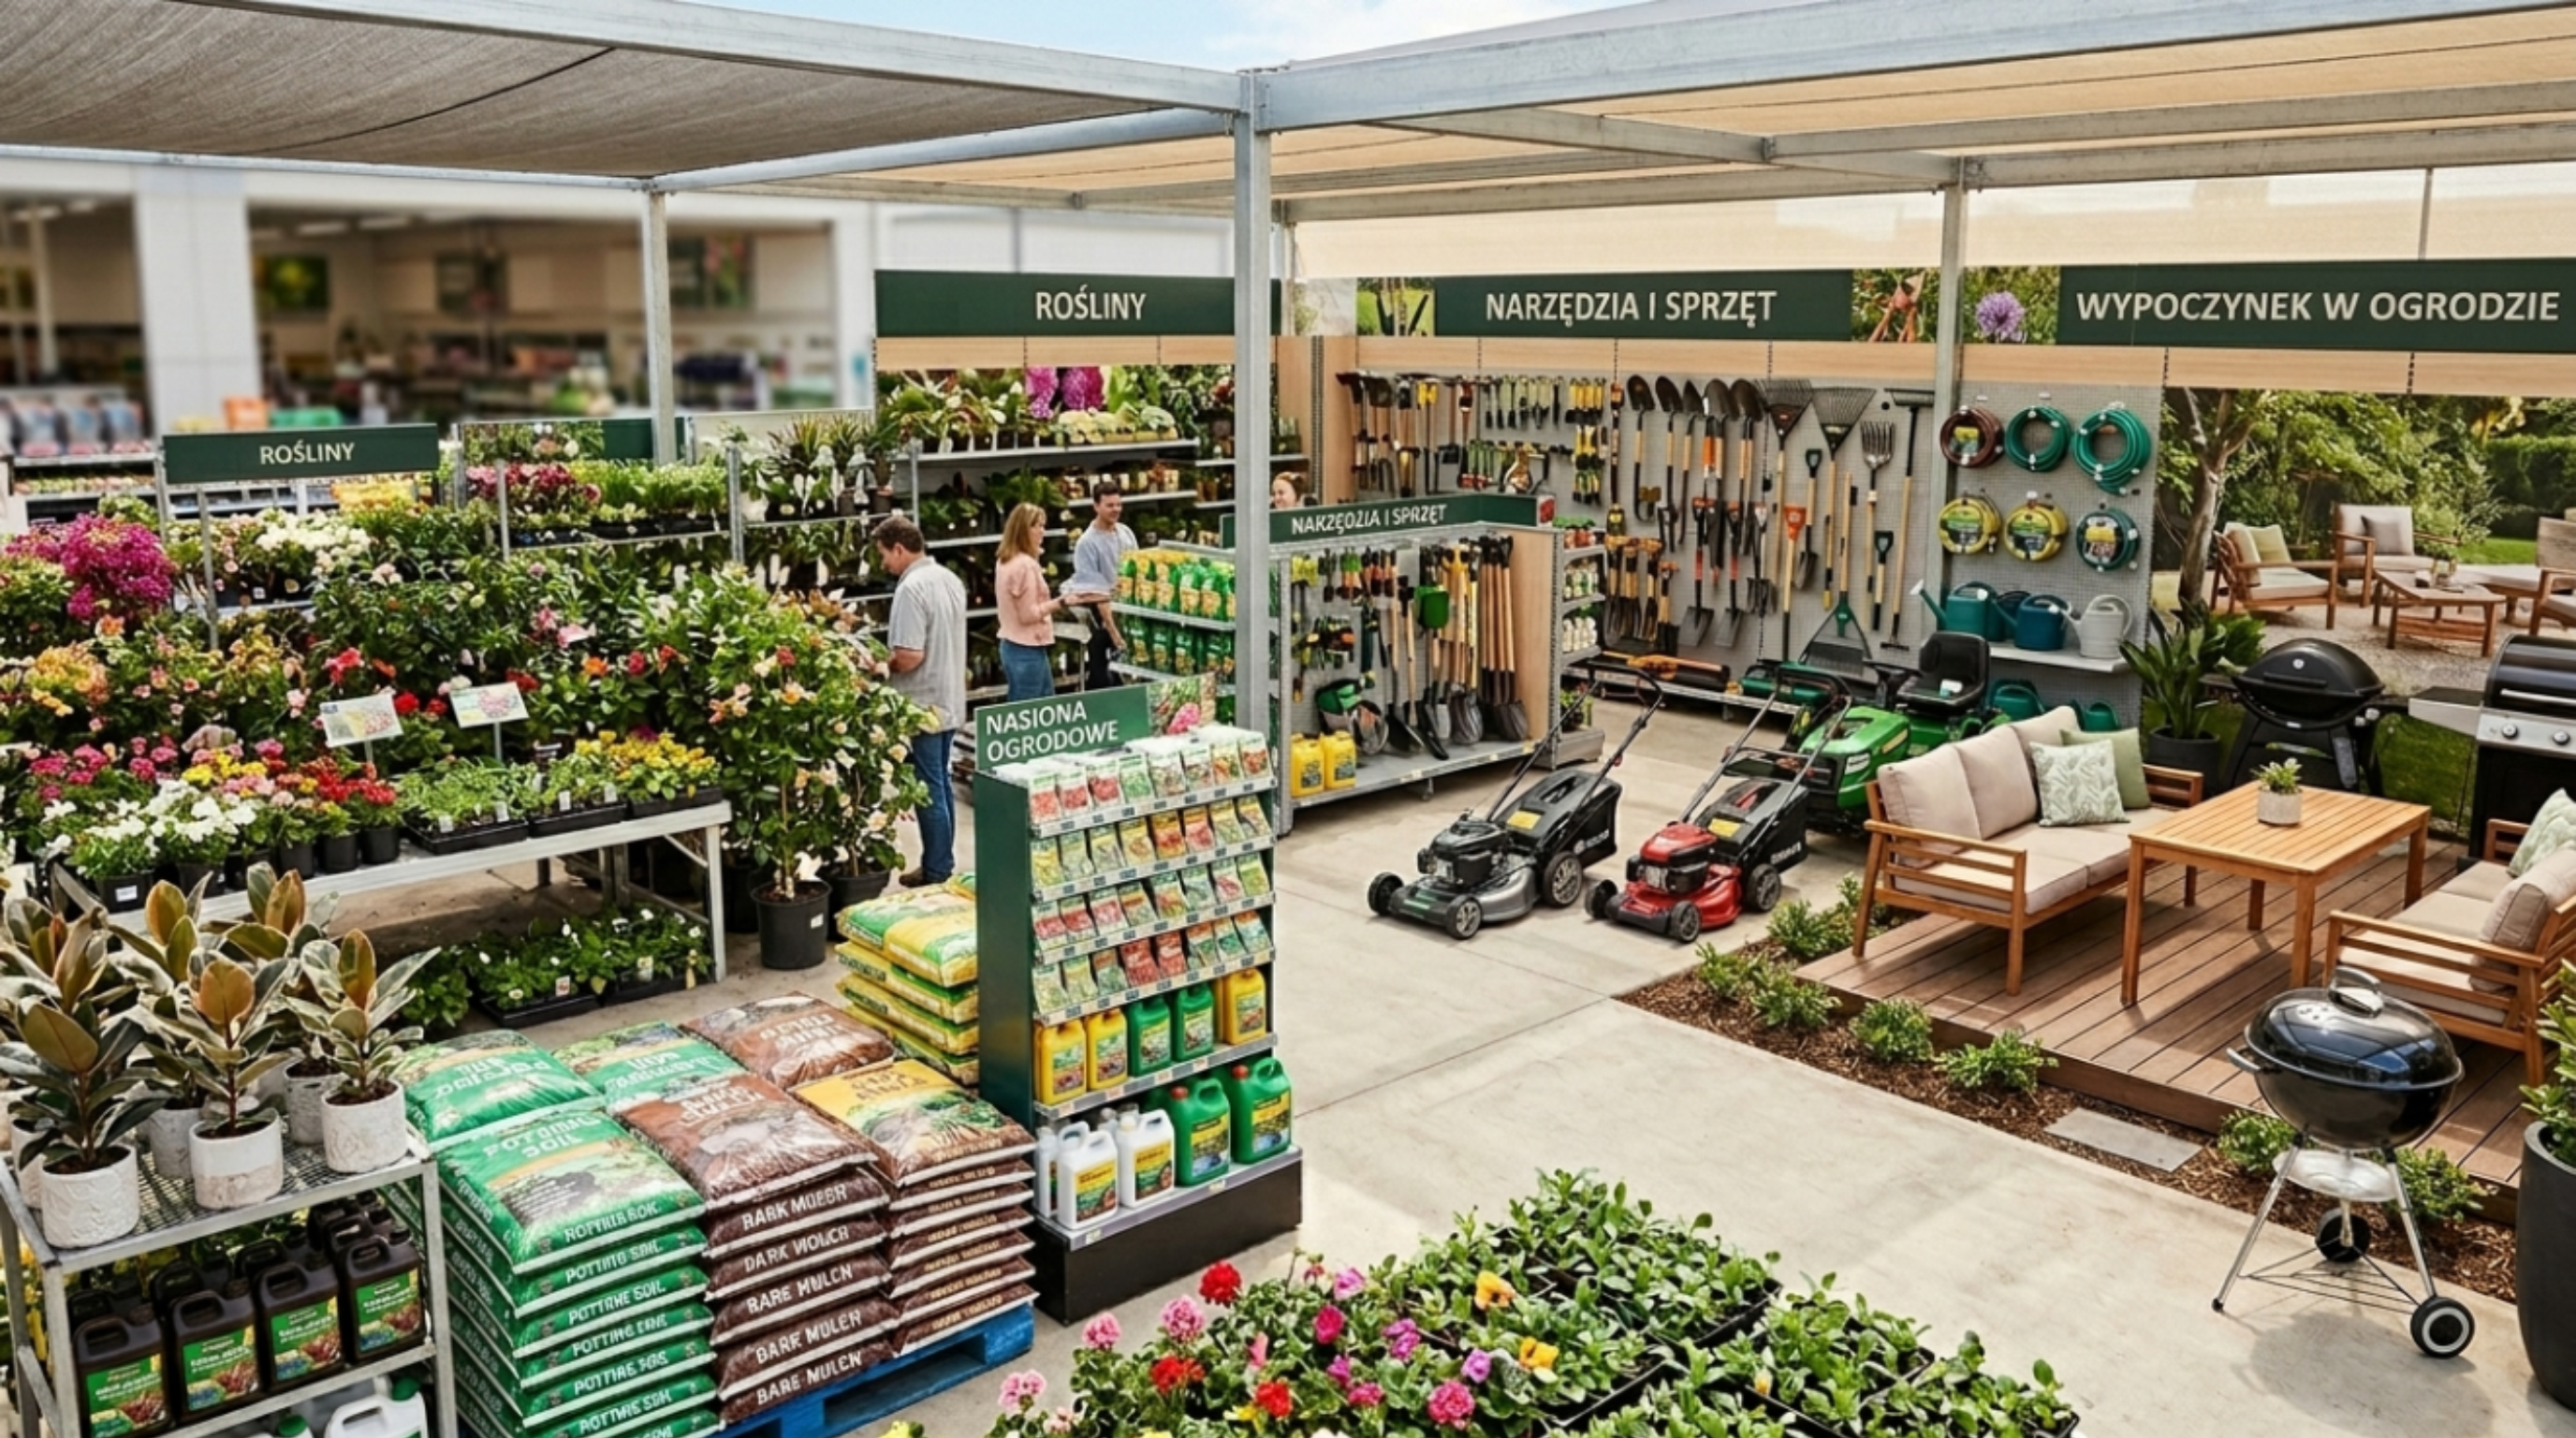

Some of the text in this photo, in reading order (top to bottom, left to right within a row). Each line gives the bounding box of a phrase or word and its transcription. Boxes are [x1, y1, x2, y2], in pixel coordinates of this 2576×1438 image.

[1035, 284, 1147, 320] ROŚLINY
[1486, 290, 1777, 328] NARZĘDZIA I SPRZĘT
[2076, 291, 2561, 321] WYPOCZYNEK W OGRODZIE
[259, 438, 355, 464] ROŚLINY
[1384, 509, 1390, 527] I
[986, 700, 1087, 736] NASIONA
[987, 720, 1119, 762] OGRODOWE
